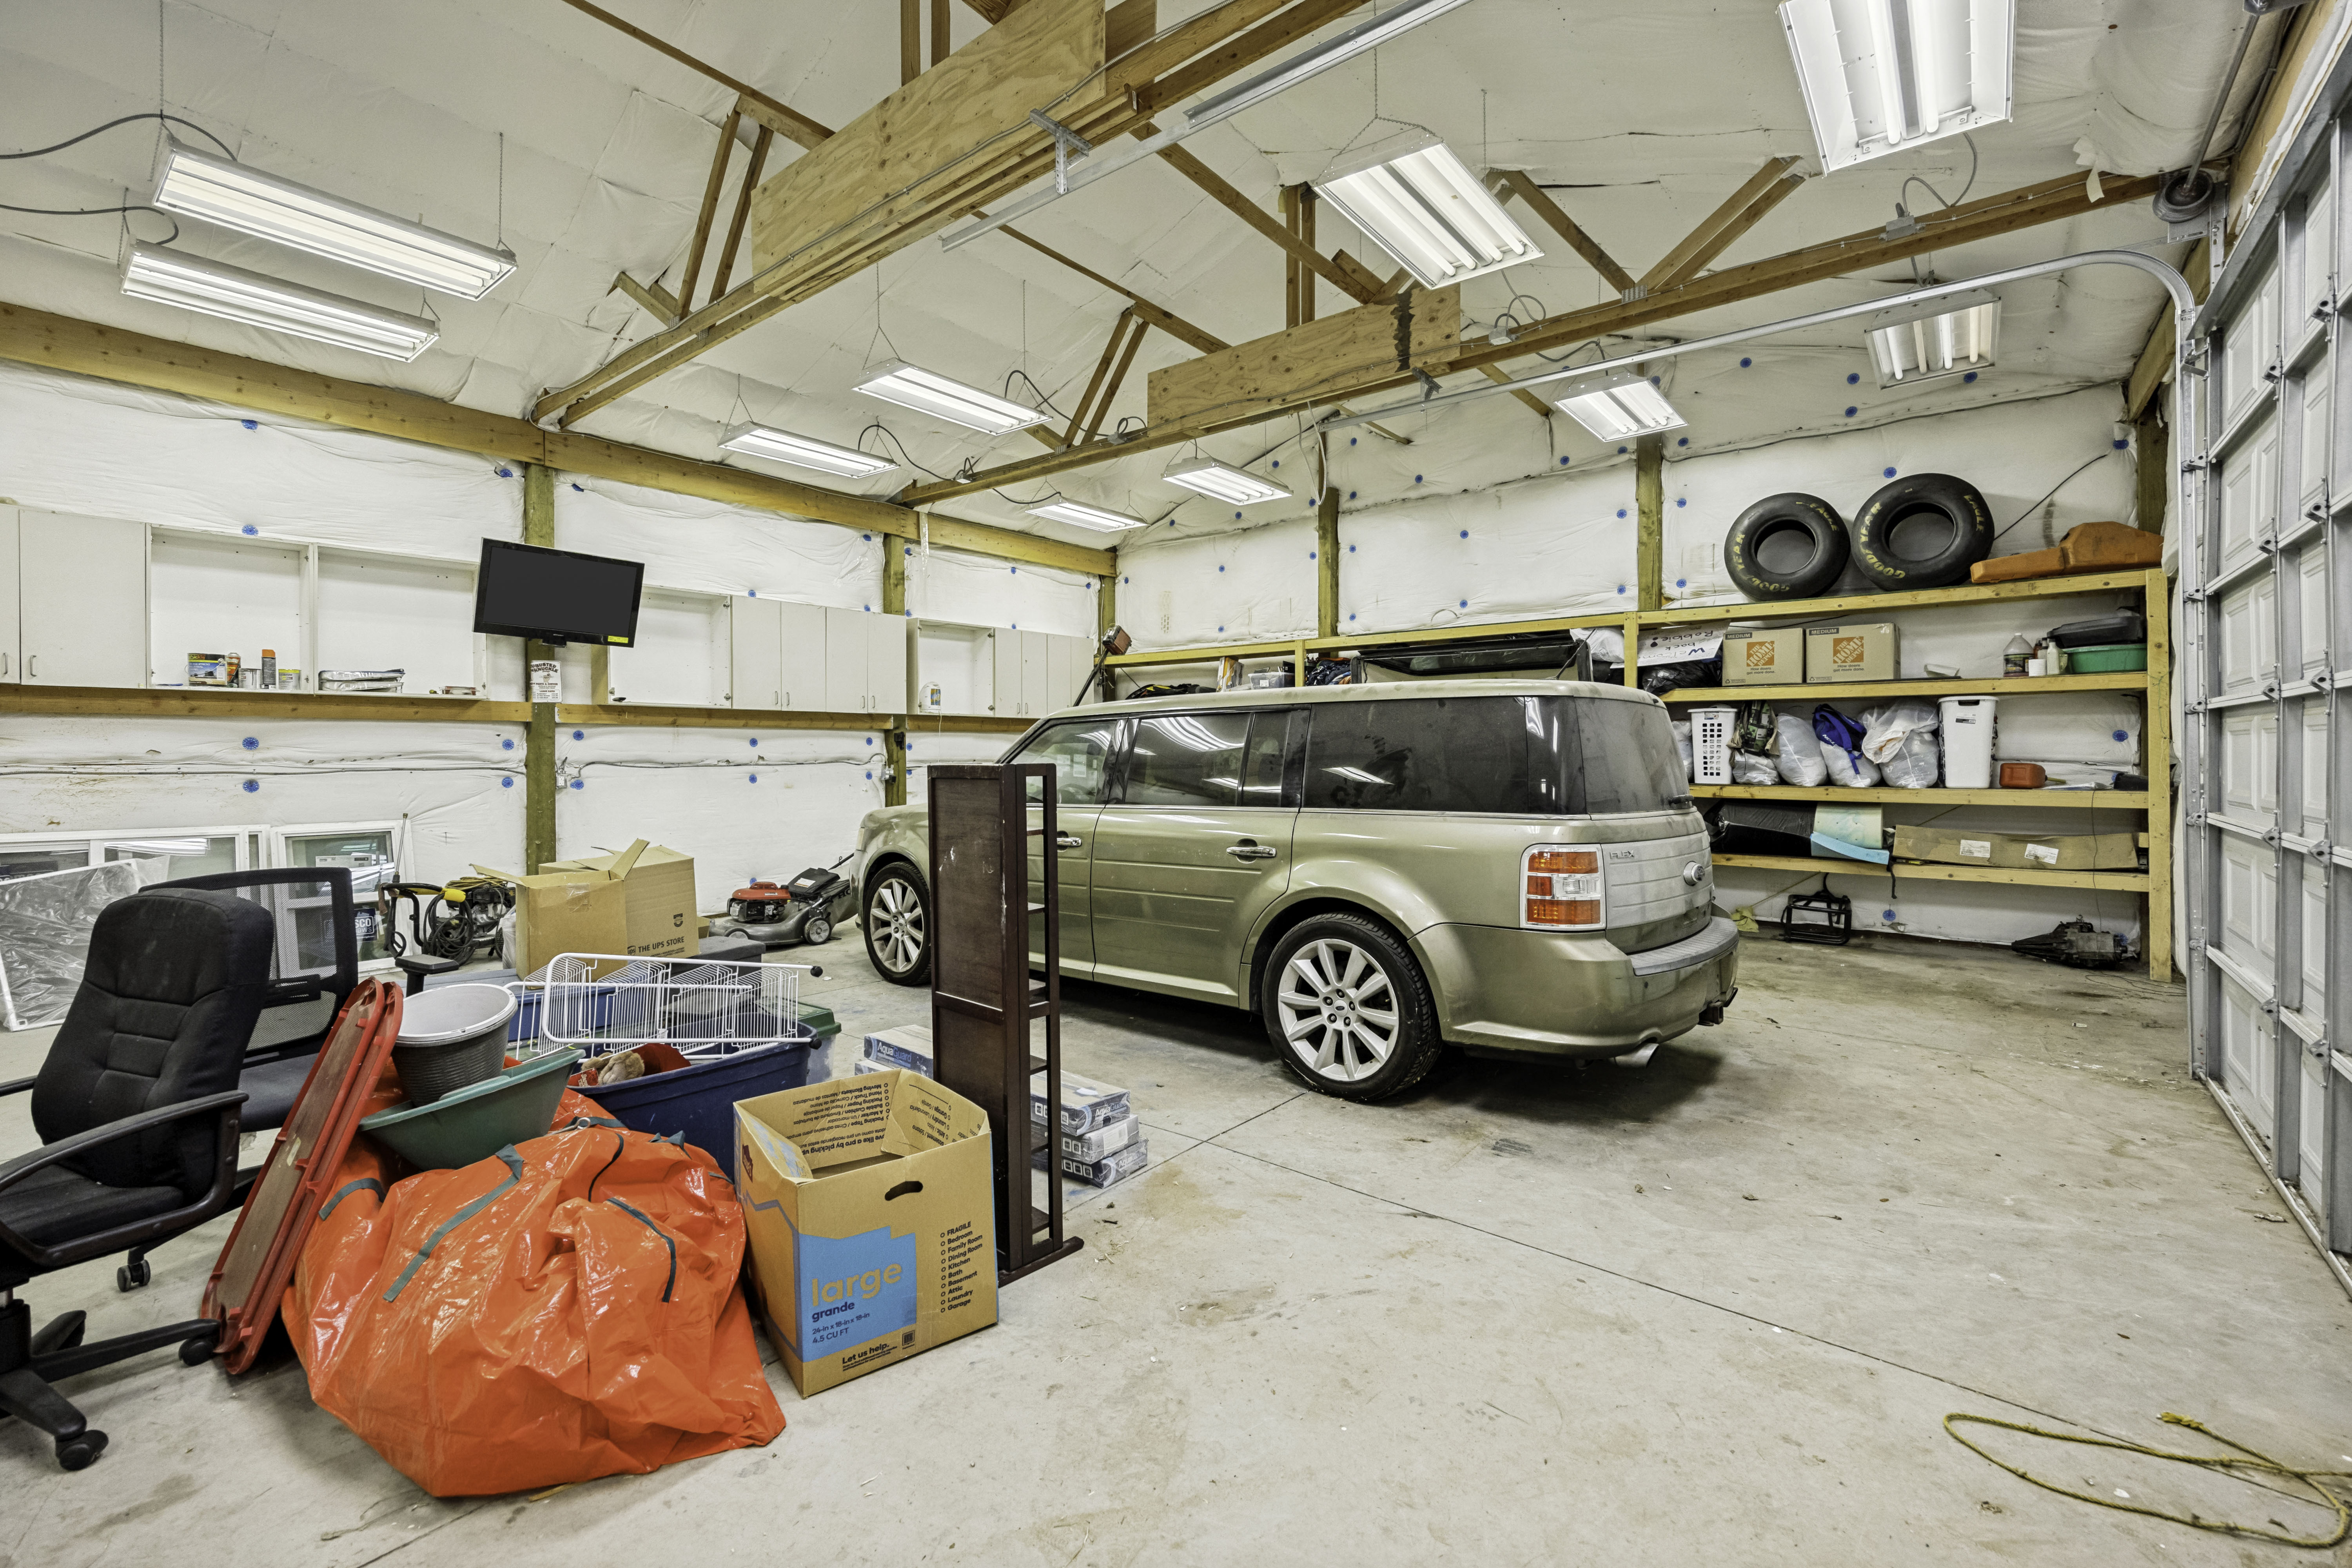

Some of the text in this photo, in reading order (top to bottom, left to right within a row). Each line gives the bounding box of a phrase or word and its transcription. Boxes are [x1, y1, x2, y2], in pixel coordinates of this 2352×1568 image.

[1809, 503, 1839, 531] EAGLE
[1964, 494, 1985, 533] EAGLE
[1665, 642, 1695, 650] back
[1749, 644, 1761, 655] THE
[1833, 637, 1864, 664] HOME
[1836, 640, 1849, 651] THE
[1746, 641, 1775, 666] HOME
[1757, 650, 1775, 666] DEPOT
[1845, 646, 1864, 663] DEPOT
[1610, 850, 1634, 859] FLEX
[638, 944, 650, 953] THE
[652, 941, 664, 949] UPS
[666, 936, 684, 946] STORE
[878, 1042, 911, 1062] AquaGuard
[934, 1106, 947, 1119] Garage
[932, 1114, 946, 1129] Laundry
[820, 1135, 846, 1144] recogiendo
[937, 1129, 945, 1140] Attic
[811, 1143, 835, 1153] picking
[947, 1221, 971, 1236] FRAGILE
[947, 1230, 973, 1245] Bedroom
[948, 1235, 983, 1253] Family Room
[948, 1243, 983, 1262] Dining Room
[948, 1258, 970, 1270] Kitchen
[948, 1269, 962, 1278] Bath
[948, 1270, 977, 1287] Basement
[812, 1263, 902, 1307] large
[948, 1285, 963, 1295] Attic
[948, 1289, 973, 1303] Laundry
[812, 1301, 855, 1323] grande
[947, 1299, 971, 1310] Garage
[812, 1326, 829, 1335] 24-in
[835, 1320, 850, 1328] 18-in
[855, 1313, 870, 1321] 18-in
[813, 1327, 849, 1343] 4.5 CU FT
[842, 1343, 889, 1364] Let us help.
